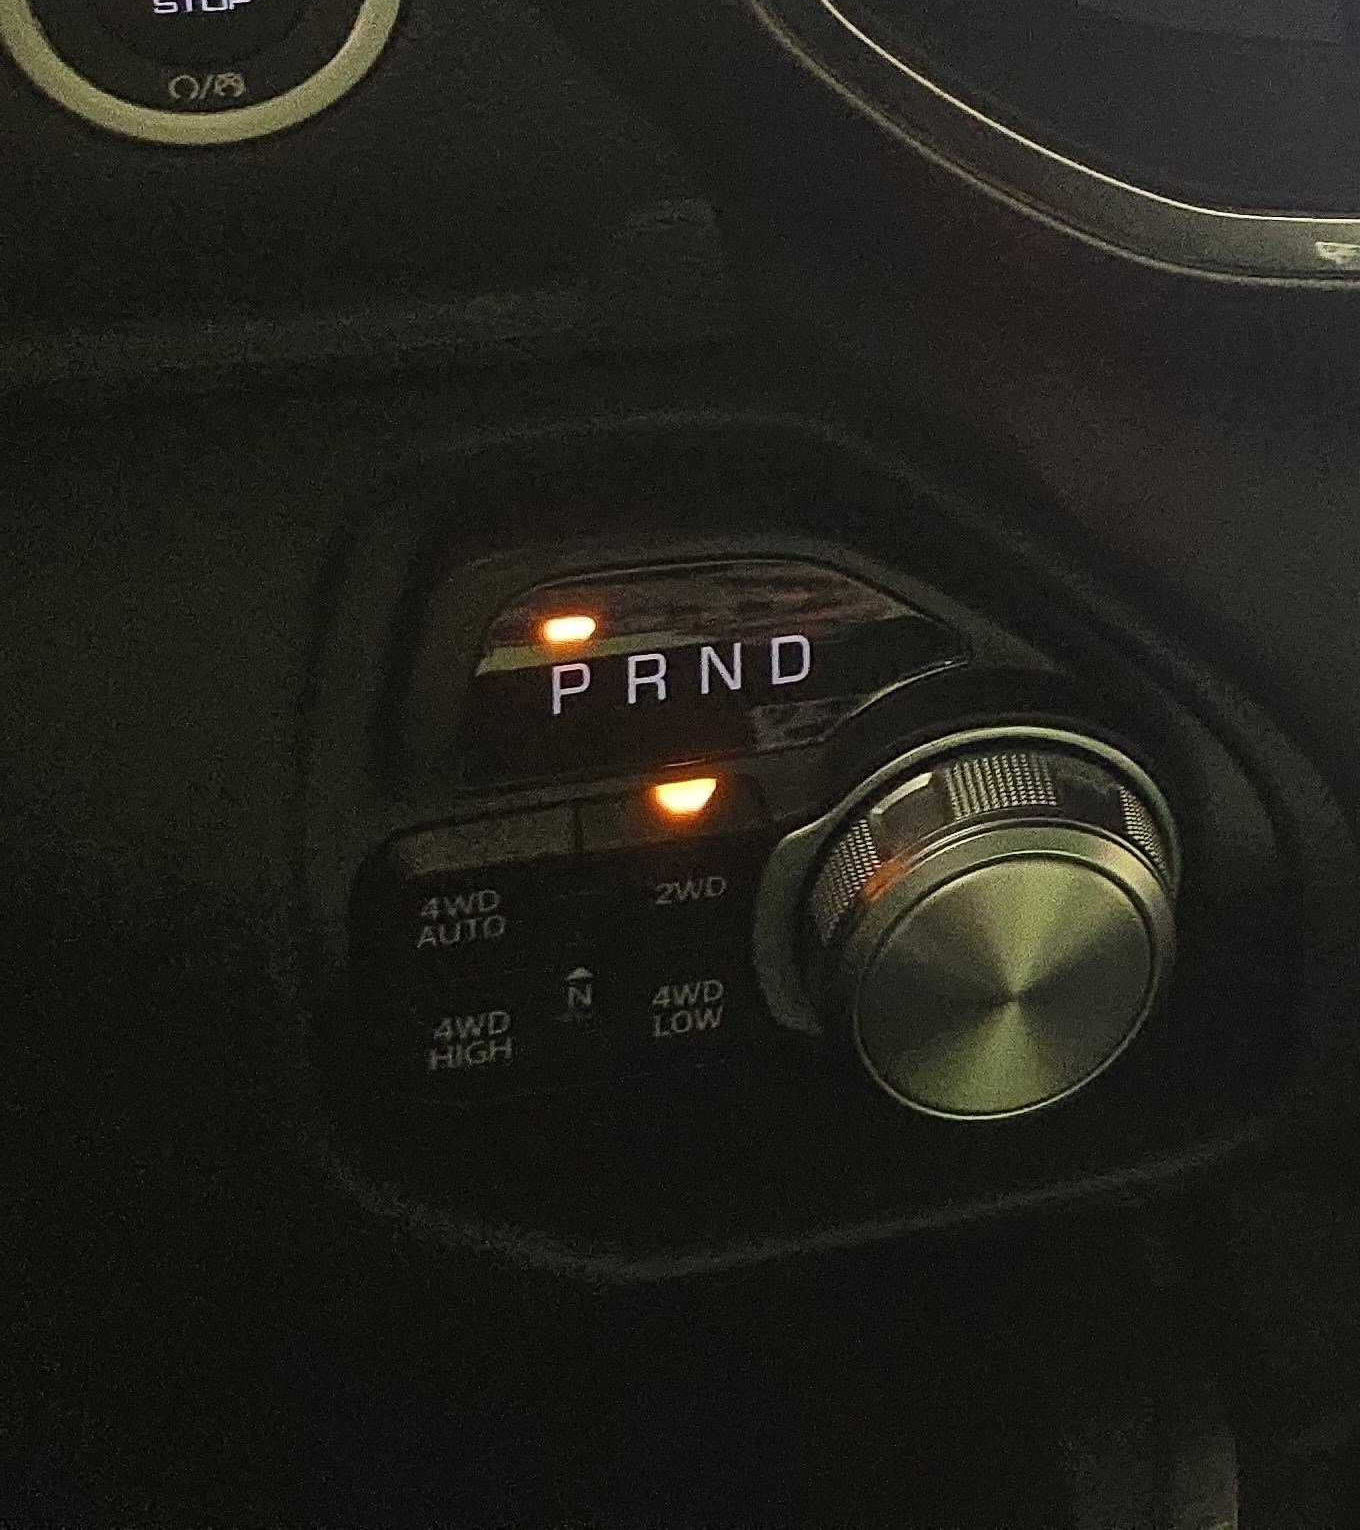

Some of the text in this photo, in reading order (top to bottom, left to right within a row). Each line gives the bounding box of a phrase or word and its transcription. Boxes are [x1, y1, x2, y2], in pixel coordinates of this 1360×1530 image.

[421, 889, 500, 921] 4WD
[655, 875, 727, 906] 2WD
[417, 916, 506, 949] AUTO
[652, 979, 724, 1008] 4WD
[433, 1011, 511, 1041] 4WD
[653, 1005, 724, 1038] LOW
[429, 1036, 513, 1071] HIGH
